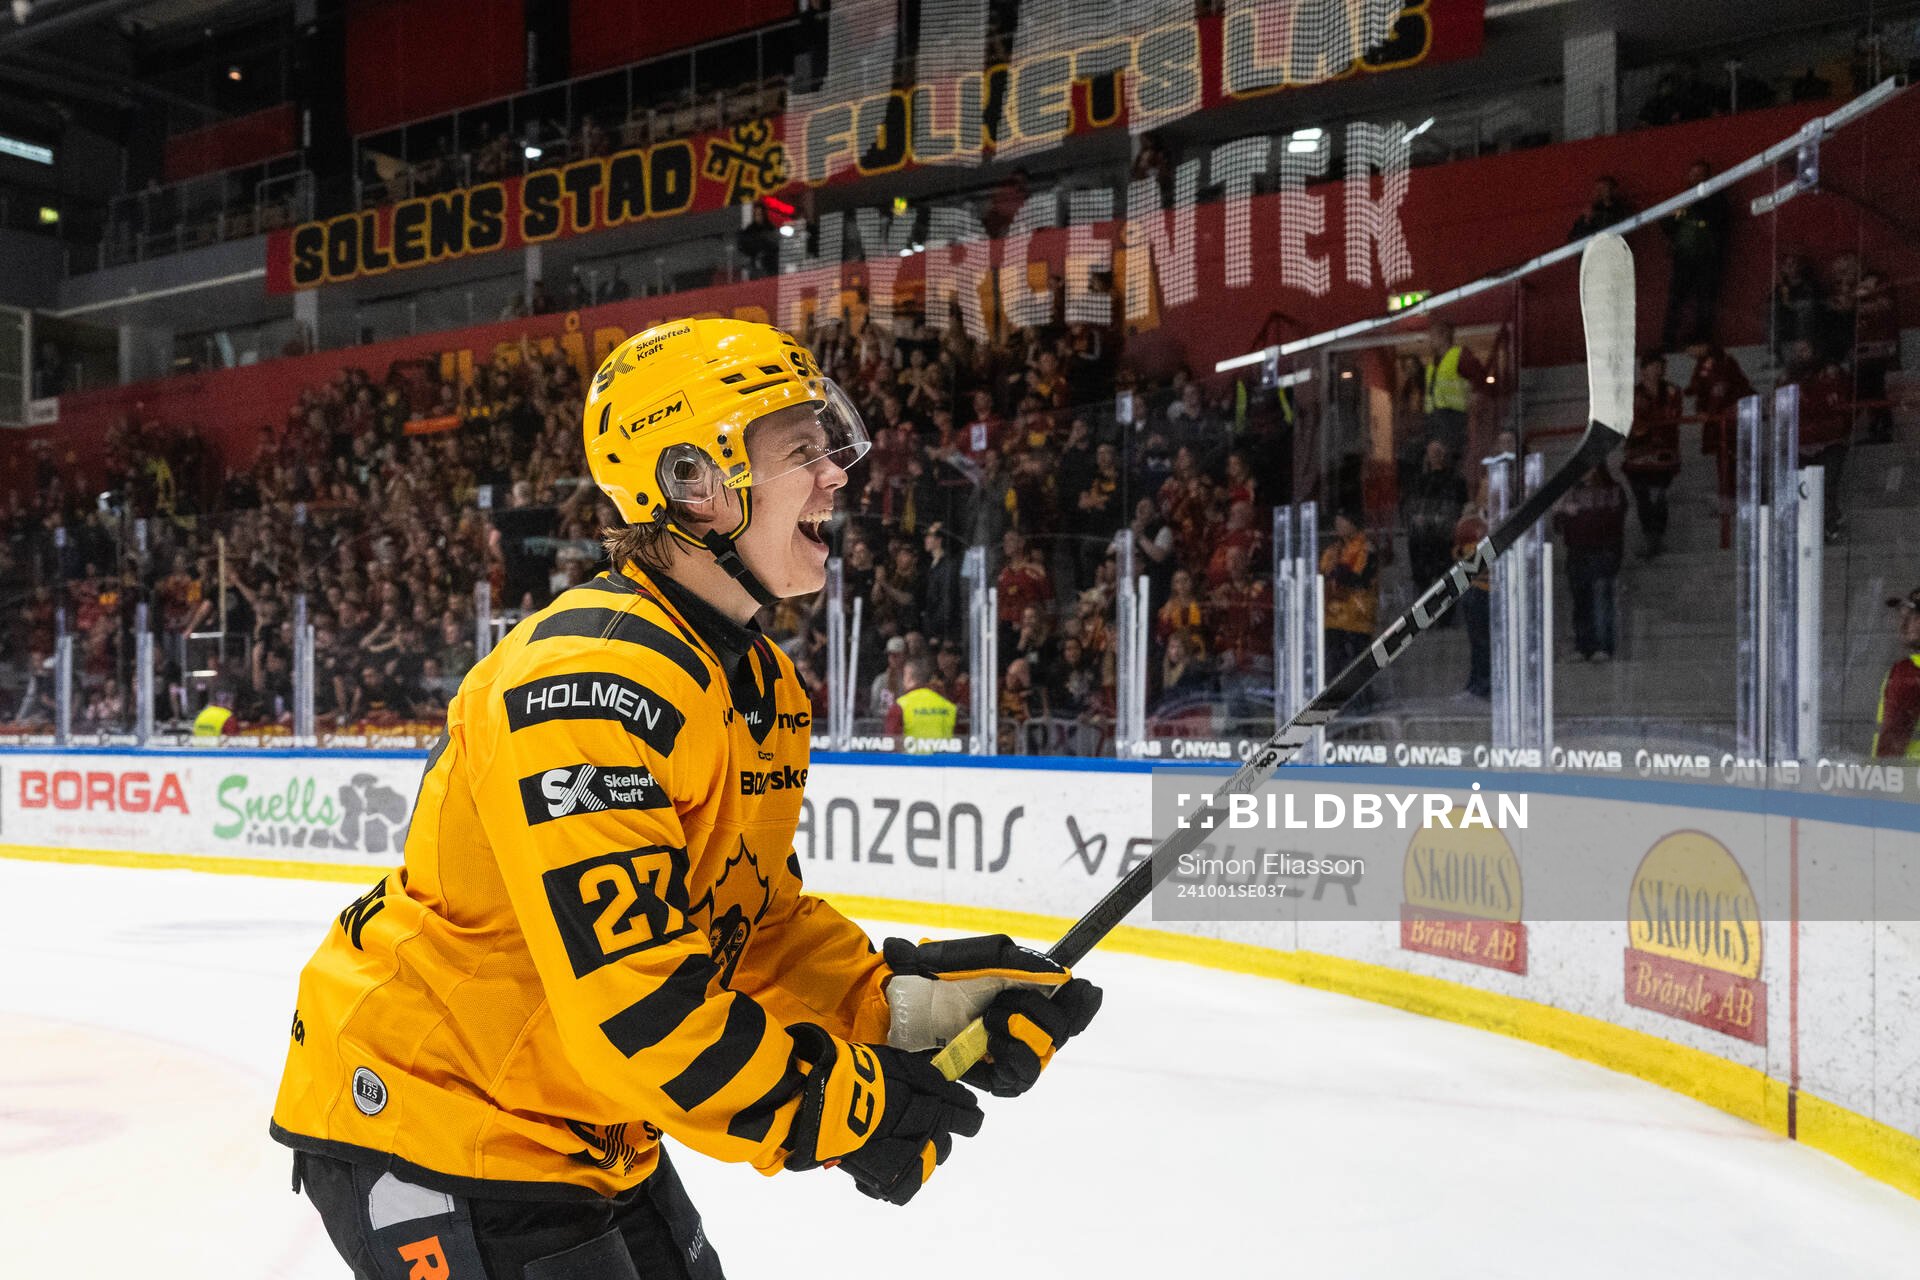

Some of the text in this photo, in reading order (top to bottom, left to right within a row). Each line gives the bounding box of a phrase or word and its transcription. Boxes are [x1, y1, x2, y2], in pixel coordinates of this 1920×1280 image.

[291, 139, 697, 289] SOLENS STAD
[777, 121, 1413, 345] HYRCENTER
[635, 325, 691, 351] Skellefteå
[636, 343, 664, 361] Kraft
[630, 400, 683, 434] CCM
[728, 472, 750, 488] CCM
[1371, 536, 1497, 668] CCM
[525, 680, 662, 731] HOLMEN
[1185, 740, 1232, 758] NYAB
[1337, 744, 1388, 764] NYAB
[1408, 745, 1463, 767] NYAB
[1494, 748, 1542, 769] NYAB
[1566, 749, 1623, 772] NYAB
[1653, 754, 1711, 778] NYAB
[1836, 763, 1905, 793] NYAB
[19, 770, 191, 815] BORGA
[213, 774, 340, 840] Snells
[609, 788, 645, 803] Kraft
[578, 851, 685, 957] 27
[1411, 846, 1515, 913] SKOOGS
[1410, 916, 1517, 962] Bränsle AB
[1637, 878, 1752, 967] SKOOGS
[1635, 961, 1755, 1030] Bränsle AB
[361, 1084, 379, 1100] 125
